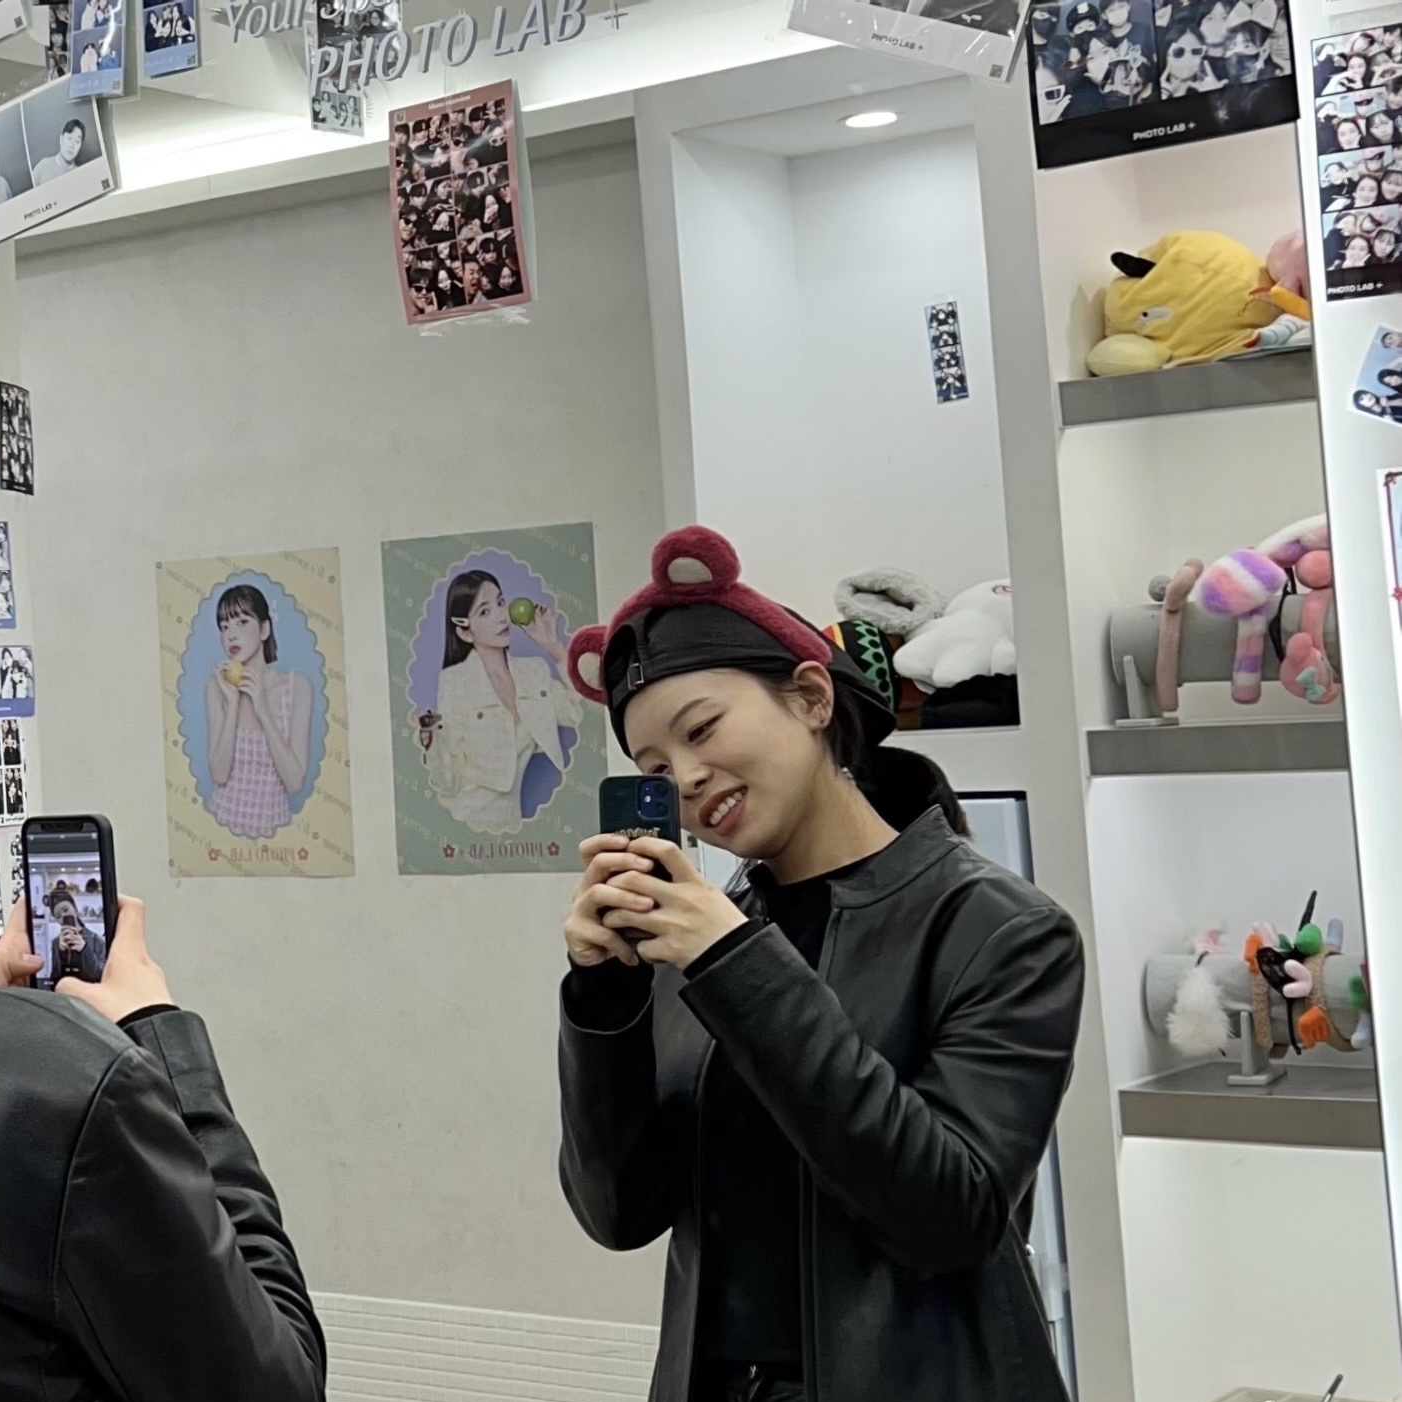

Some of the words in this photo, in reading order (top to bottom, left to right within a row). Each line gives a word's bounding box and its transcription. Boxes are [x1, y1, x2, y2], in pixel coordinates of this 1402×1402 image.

[310, 14, 477, 99] PHOTO
[494, 0, 587, 56] LAB
[871, 33, 899, 46] PHOTO
[899, 39, 916, 50] LAB
[1133, 127, 1165, 141] PHOTO
[1167, 123, 1187, 135] LAB
[24, 207, 41, 221] PHOTO
[41, 202, 53, 213] LAB
[1327, 284, 1356, 294] PHOTO
[1357, 282, 1375, 291] LAB
